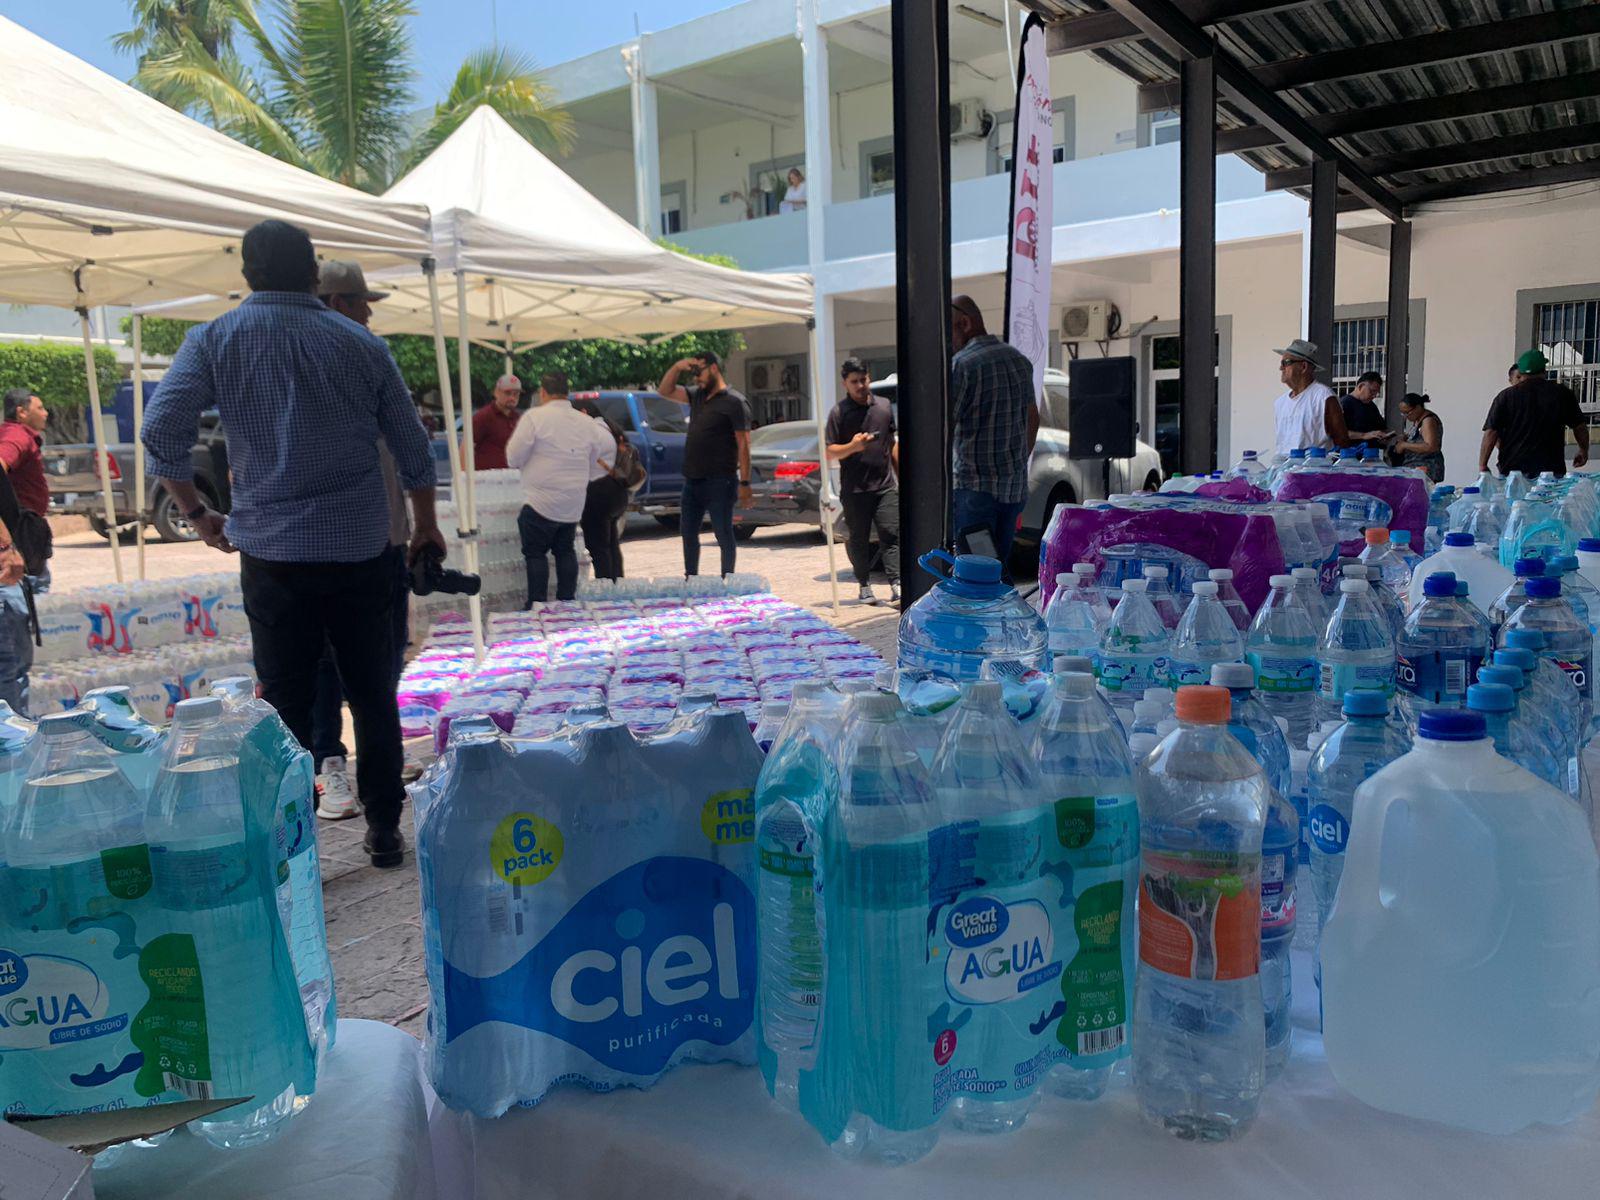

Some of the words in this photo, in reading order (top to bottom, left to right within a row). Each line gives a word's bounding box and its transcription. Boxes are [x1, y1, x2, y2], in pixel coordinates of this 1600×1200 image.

[512, 818, 537, 853] 6
[1311, 814, 1343, 844] ciel
[504, 848, 554, 876] pack
[951, 906, 998, 930] Great
[961, 924, 998, 939] Value
[550, 902, 740, 1023] ciel
[960, 936, 1045, 985] AGUA
[80, 1026, 92, 1036] DE
[608, 1013, 723, 1053] purificada
[941, 1037, 949, 1054] 6
